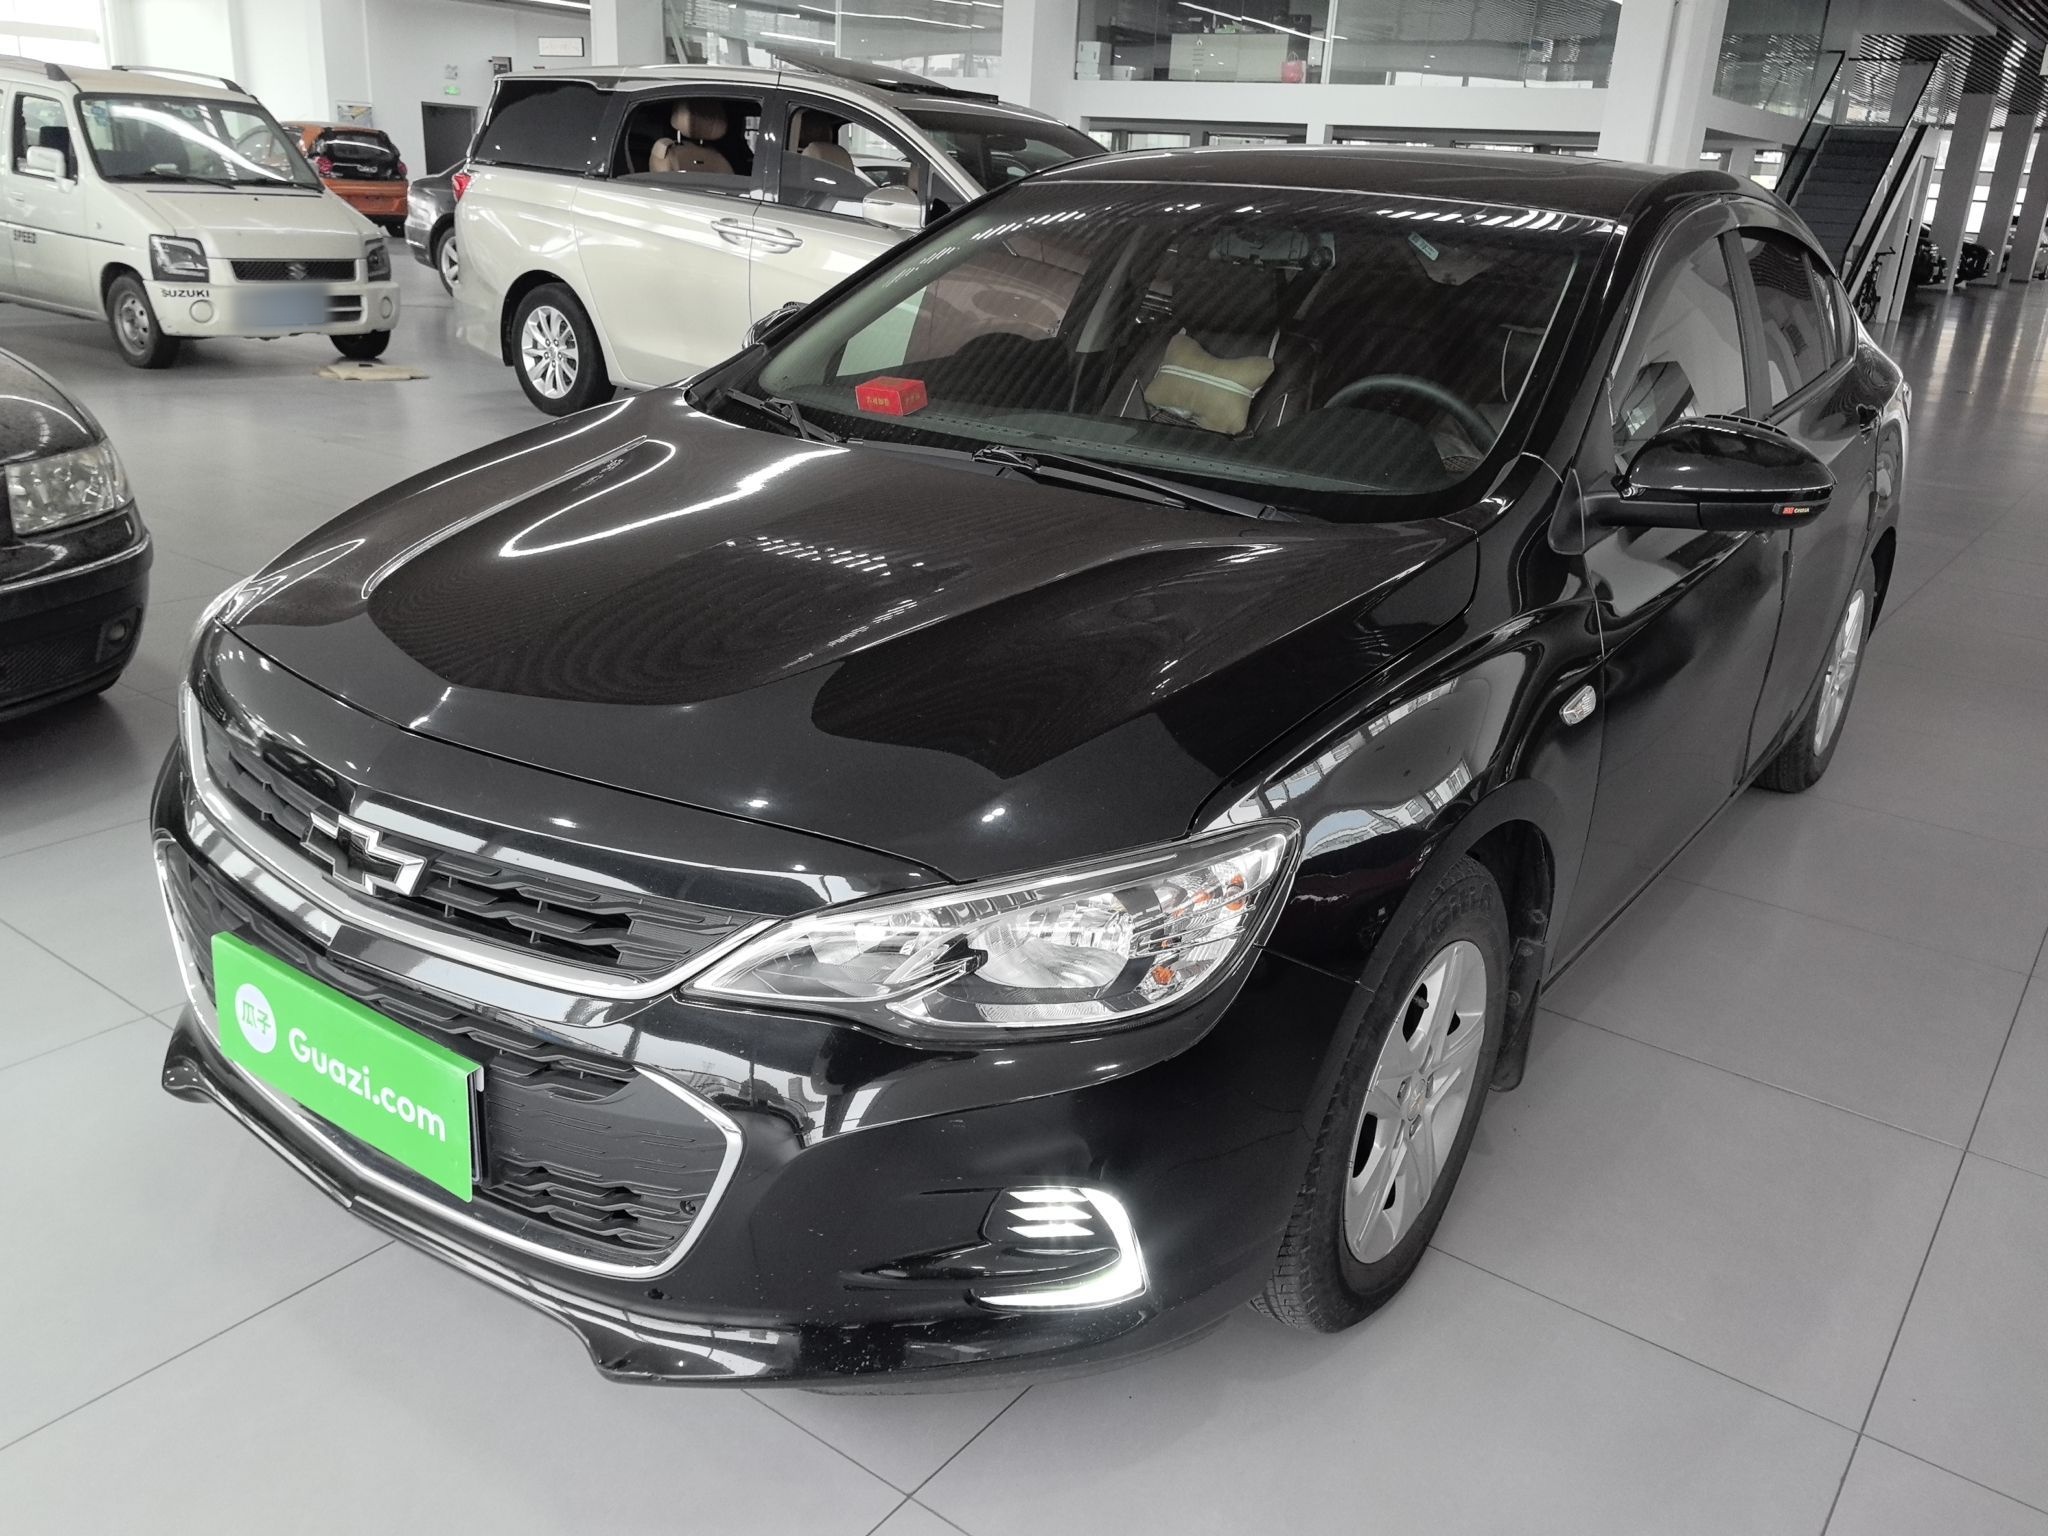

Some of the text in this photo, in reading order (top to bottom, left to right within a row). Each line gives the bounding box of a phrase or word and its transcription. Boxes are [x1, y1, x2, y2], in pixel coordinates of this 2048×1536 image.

[160, 288, 210, 298] SUZUKI
[241, 1000, 272, 1035] 瓜子
[288, 1027, 446, 1143] Guazi.com
